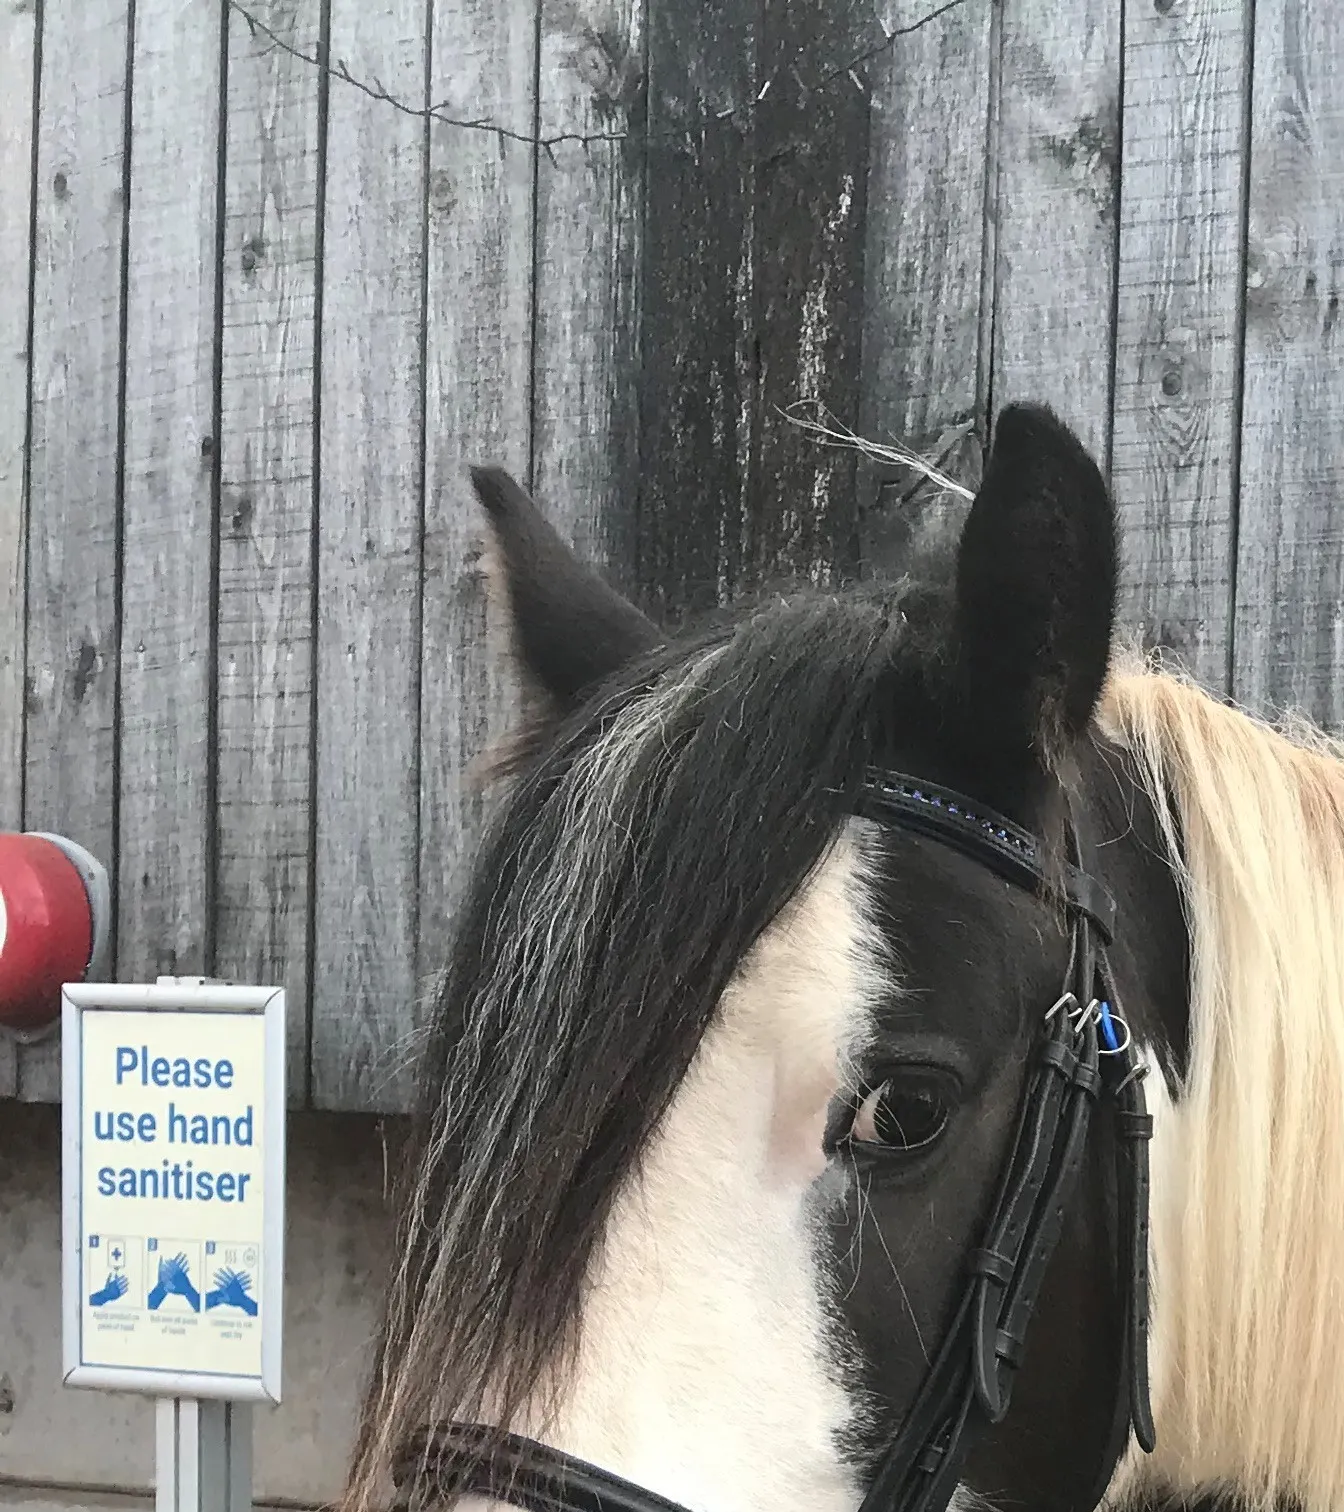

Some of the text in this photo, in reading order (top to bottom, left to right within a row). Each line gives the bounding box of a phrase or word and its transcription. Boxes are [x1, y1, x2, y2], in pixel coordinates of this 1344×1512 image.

[116, 1045, 233, 1088] Please
[94, 1103, 253, 1146] use hand
[98, 1159, 250, 1201] sanitiser
